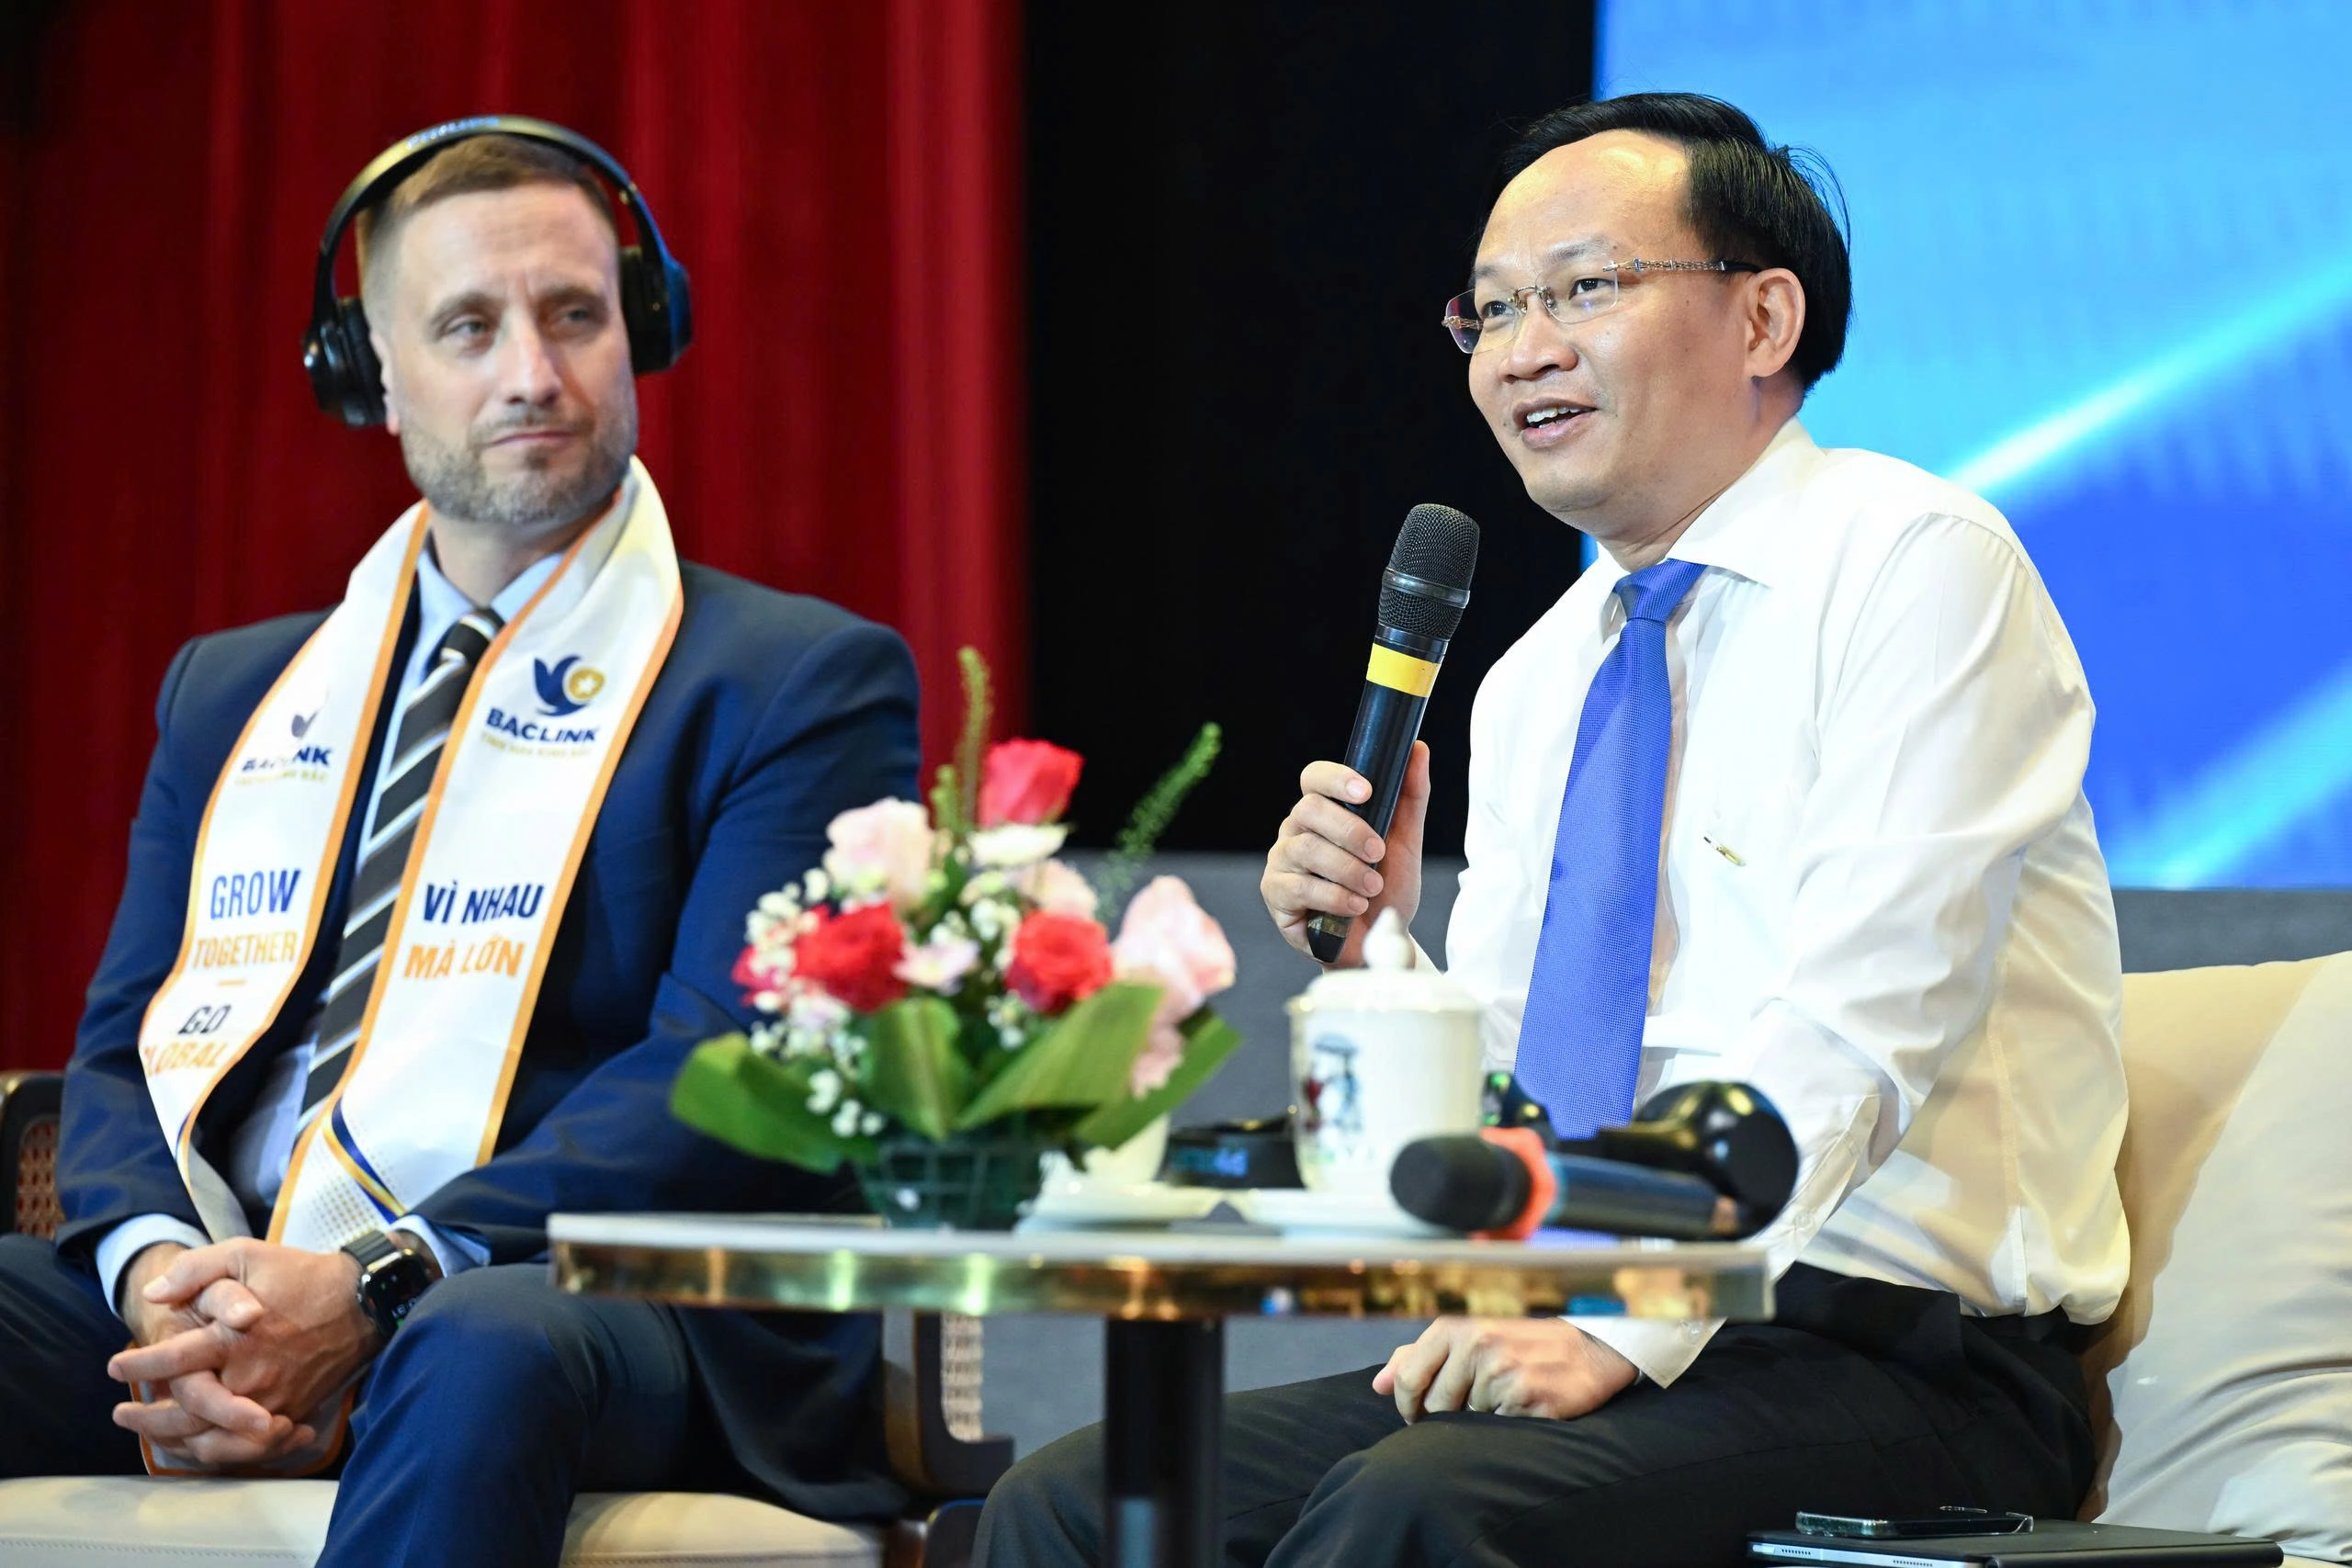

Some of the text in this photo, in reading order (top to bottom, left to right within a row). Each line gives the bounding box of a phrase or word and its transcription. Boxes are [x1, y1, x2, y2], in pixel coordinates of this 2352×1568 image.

[486, 706, 602, 743] BACLINK
[210, 868, 301, 919] GROW
[424, 880, 545, 924] VÌ NHAU
[193, 930, 299, 970] TOGETHER
[403, 934, 526, 979] MÀ LỚN
[177, 1004, 232, 1035] GO
